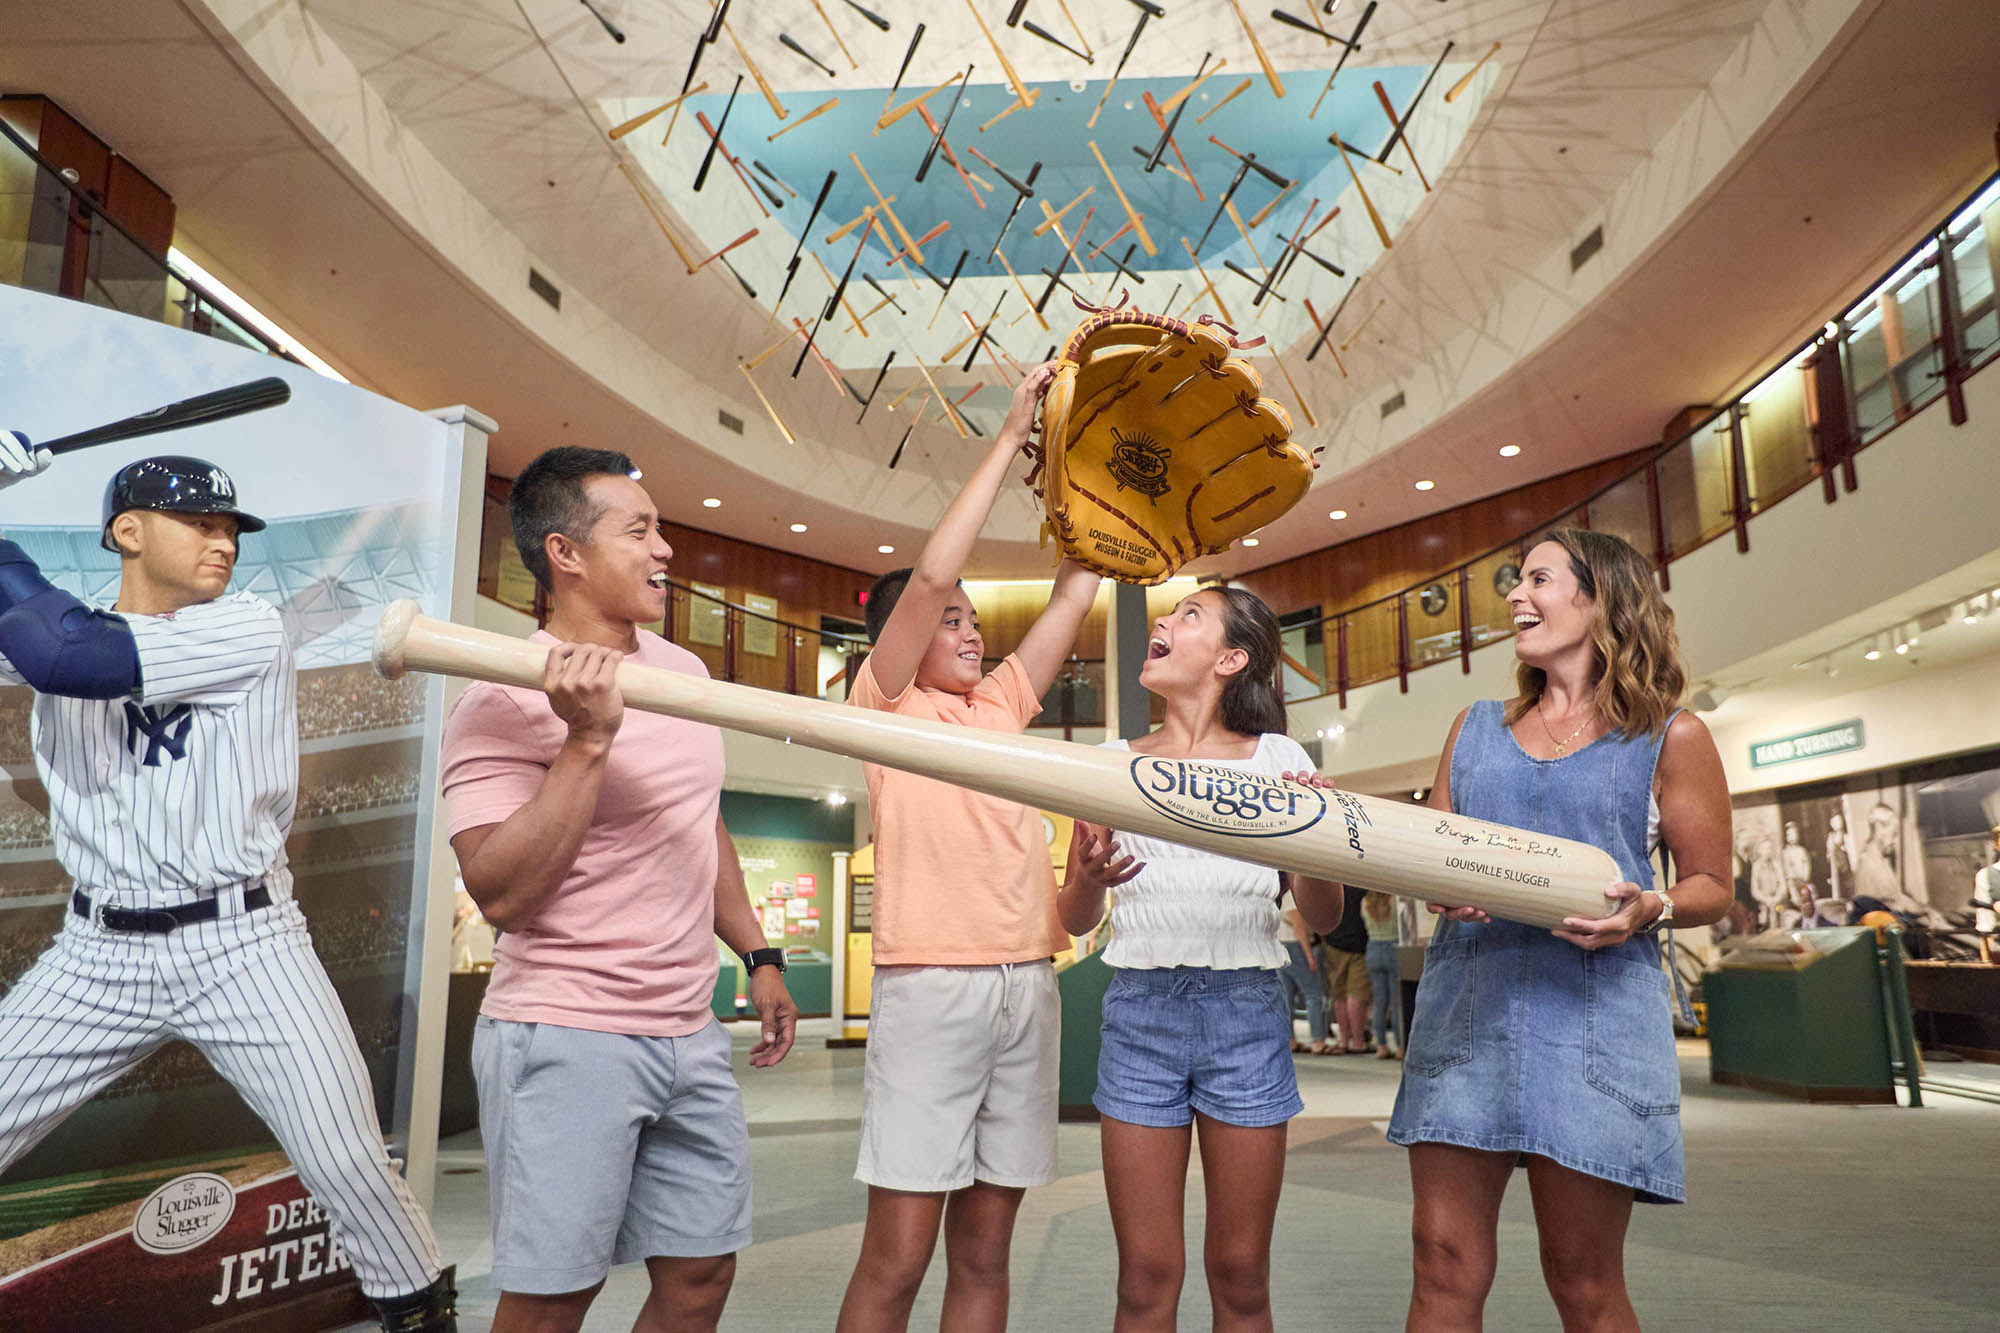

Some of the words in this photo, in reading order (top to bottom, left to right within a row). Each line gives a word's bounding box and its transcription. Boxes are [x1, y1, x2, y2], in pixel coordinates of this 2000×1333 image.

[209, 469, 233, 497] NY
[1088, 528, 1128, 550] LOUISVILLE
[1128, 542, 1157, 560] SLUGGER
[1095, 541, 1120, 559] MUSEUM
[1120, 551, 1125, 560] &
[1125, 551, 1148, 567] FACTORY
[1151, 760, 1303, 820] Slugger
[1188, 763, 1294, 791] LOUISVILLE
[1166, 799, 1186, 815] MADE
[1186, 808, 1195, 817] IN
[1196, 811, 1211, 821] THE
[1279, 820, 1288, 828] KY
[1445, 856, 1502, 878] LOUISVILLE
[1503, 869, 1550, 888] SLUGGER
[156, 1186, 225, 1217] Louisville
[265, 1197, 332, 1235] DER
[156, 1214, 212, 1238] Slugger
[211, 1233, 350, 1305] JETER
